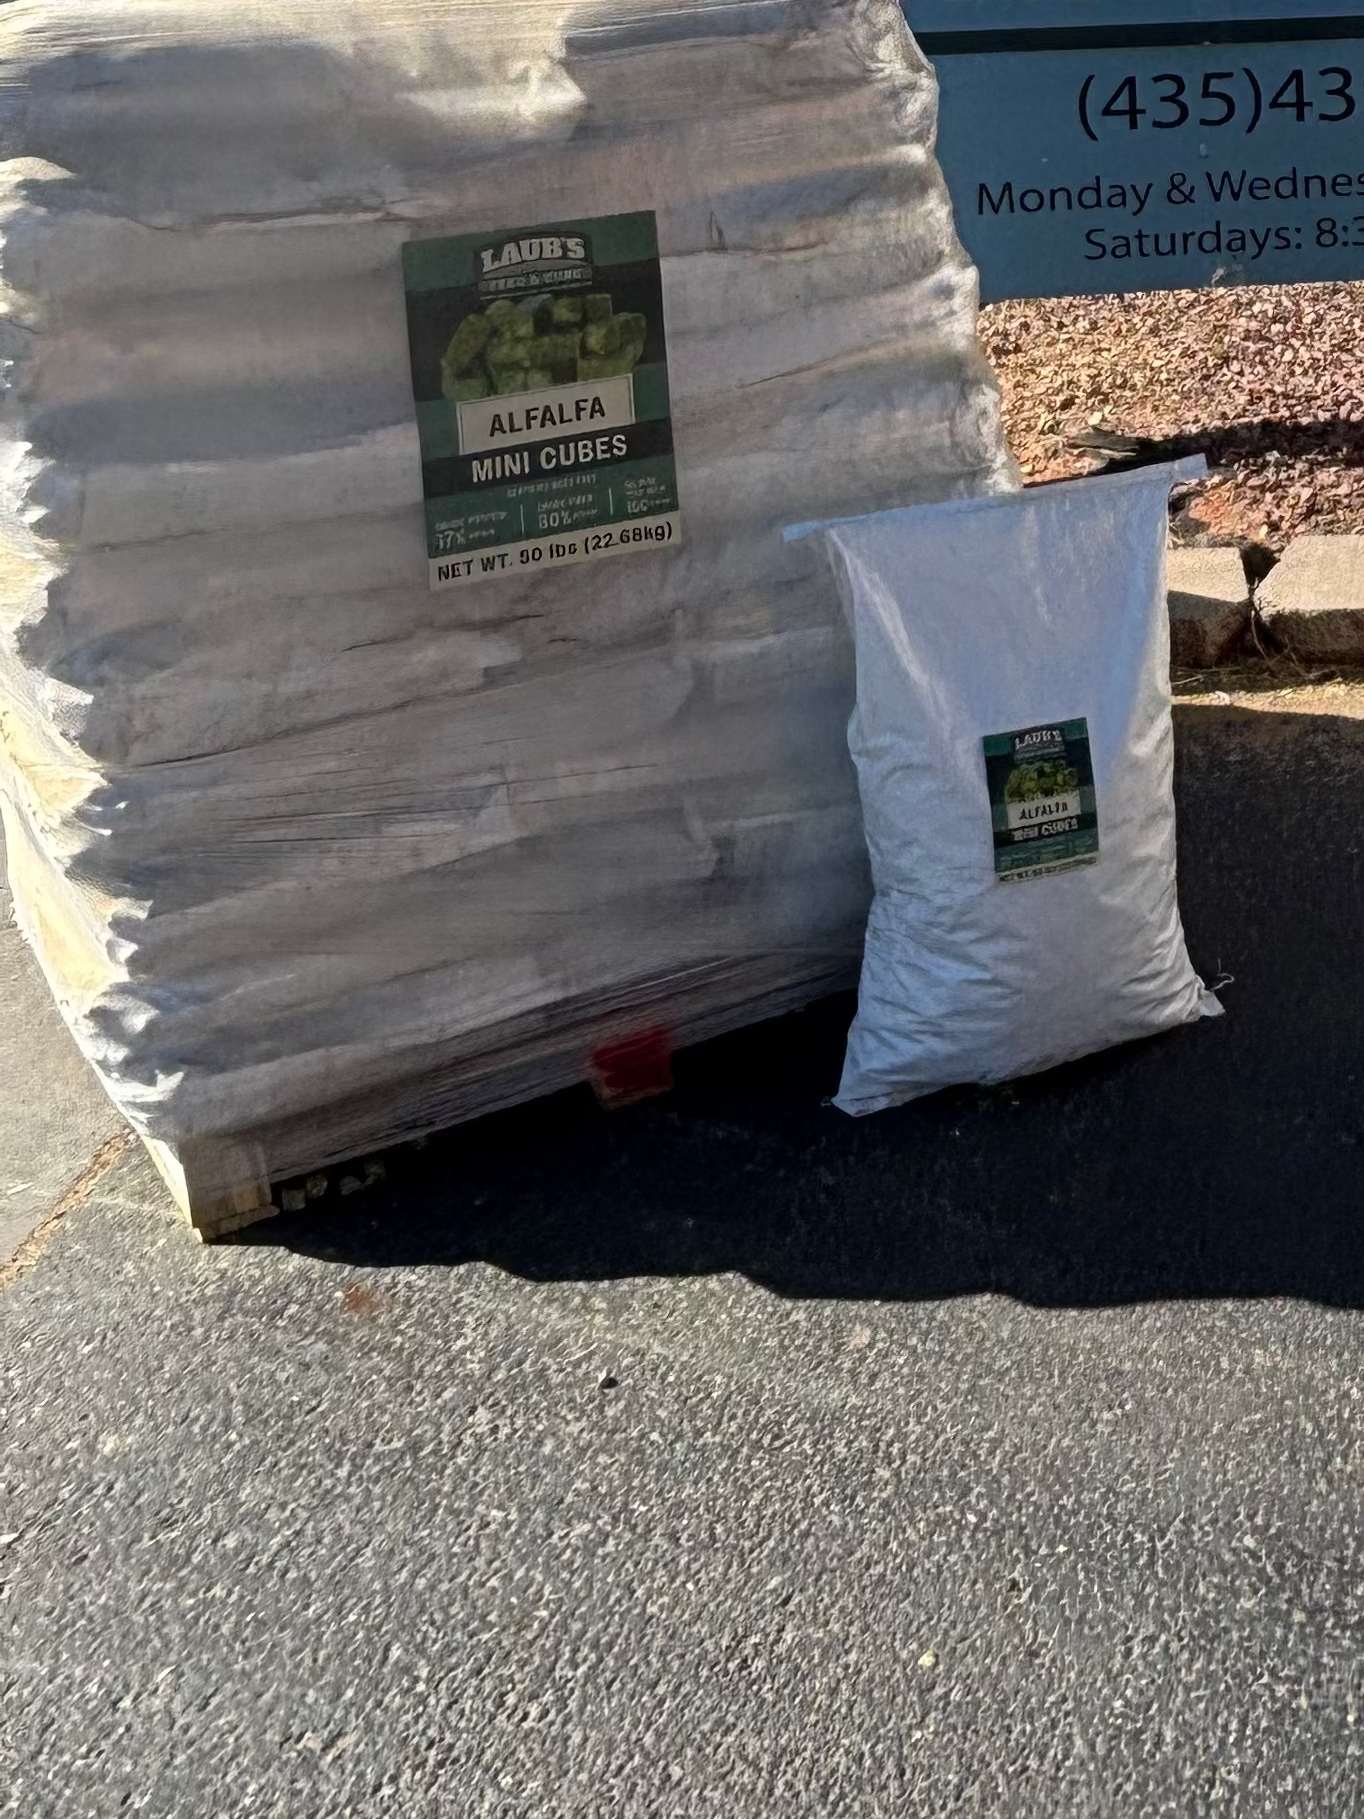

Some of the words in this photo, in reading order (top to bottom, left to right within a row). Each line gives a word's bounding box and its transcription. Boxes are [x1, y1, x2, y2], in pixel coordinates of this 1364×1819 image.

[977, 175, 1154, 217] Monday
[1166, 171, 1196, 206] &
[481, 236, 585, 274] LAUB'S
[1084, 219, 1303, 262] Saturdays:
[488, 396, 606, 438] ALFALFA
[471, 446, 530, 484] MINI
[540, 434, 628, 471] CUBES
[437, 559, 474, 582] NET
